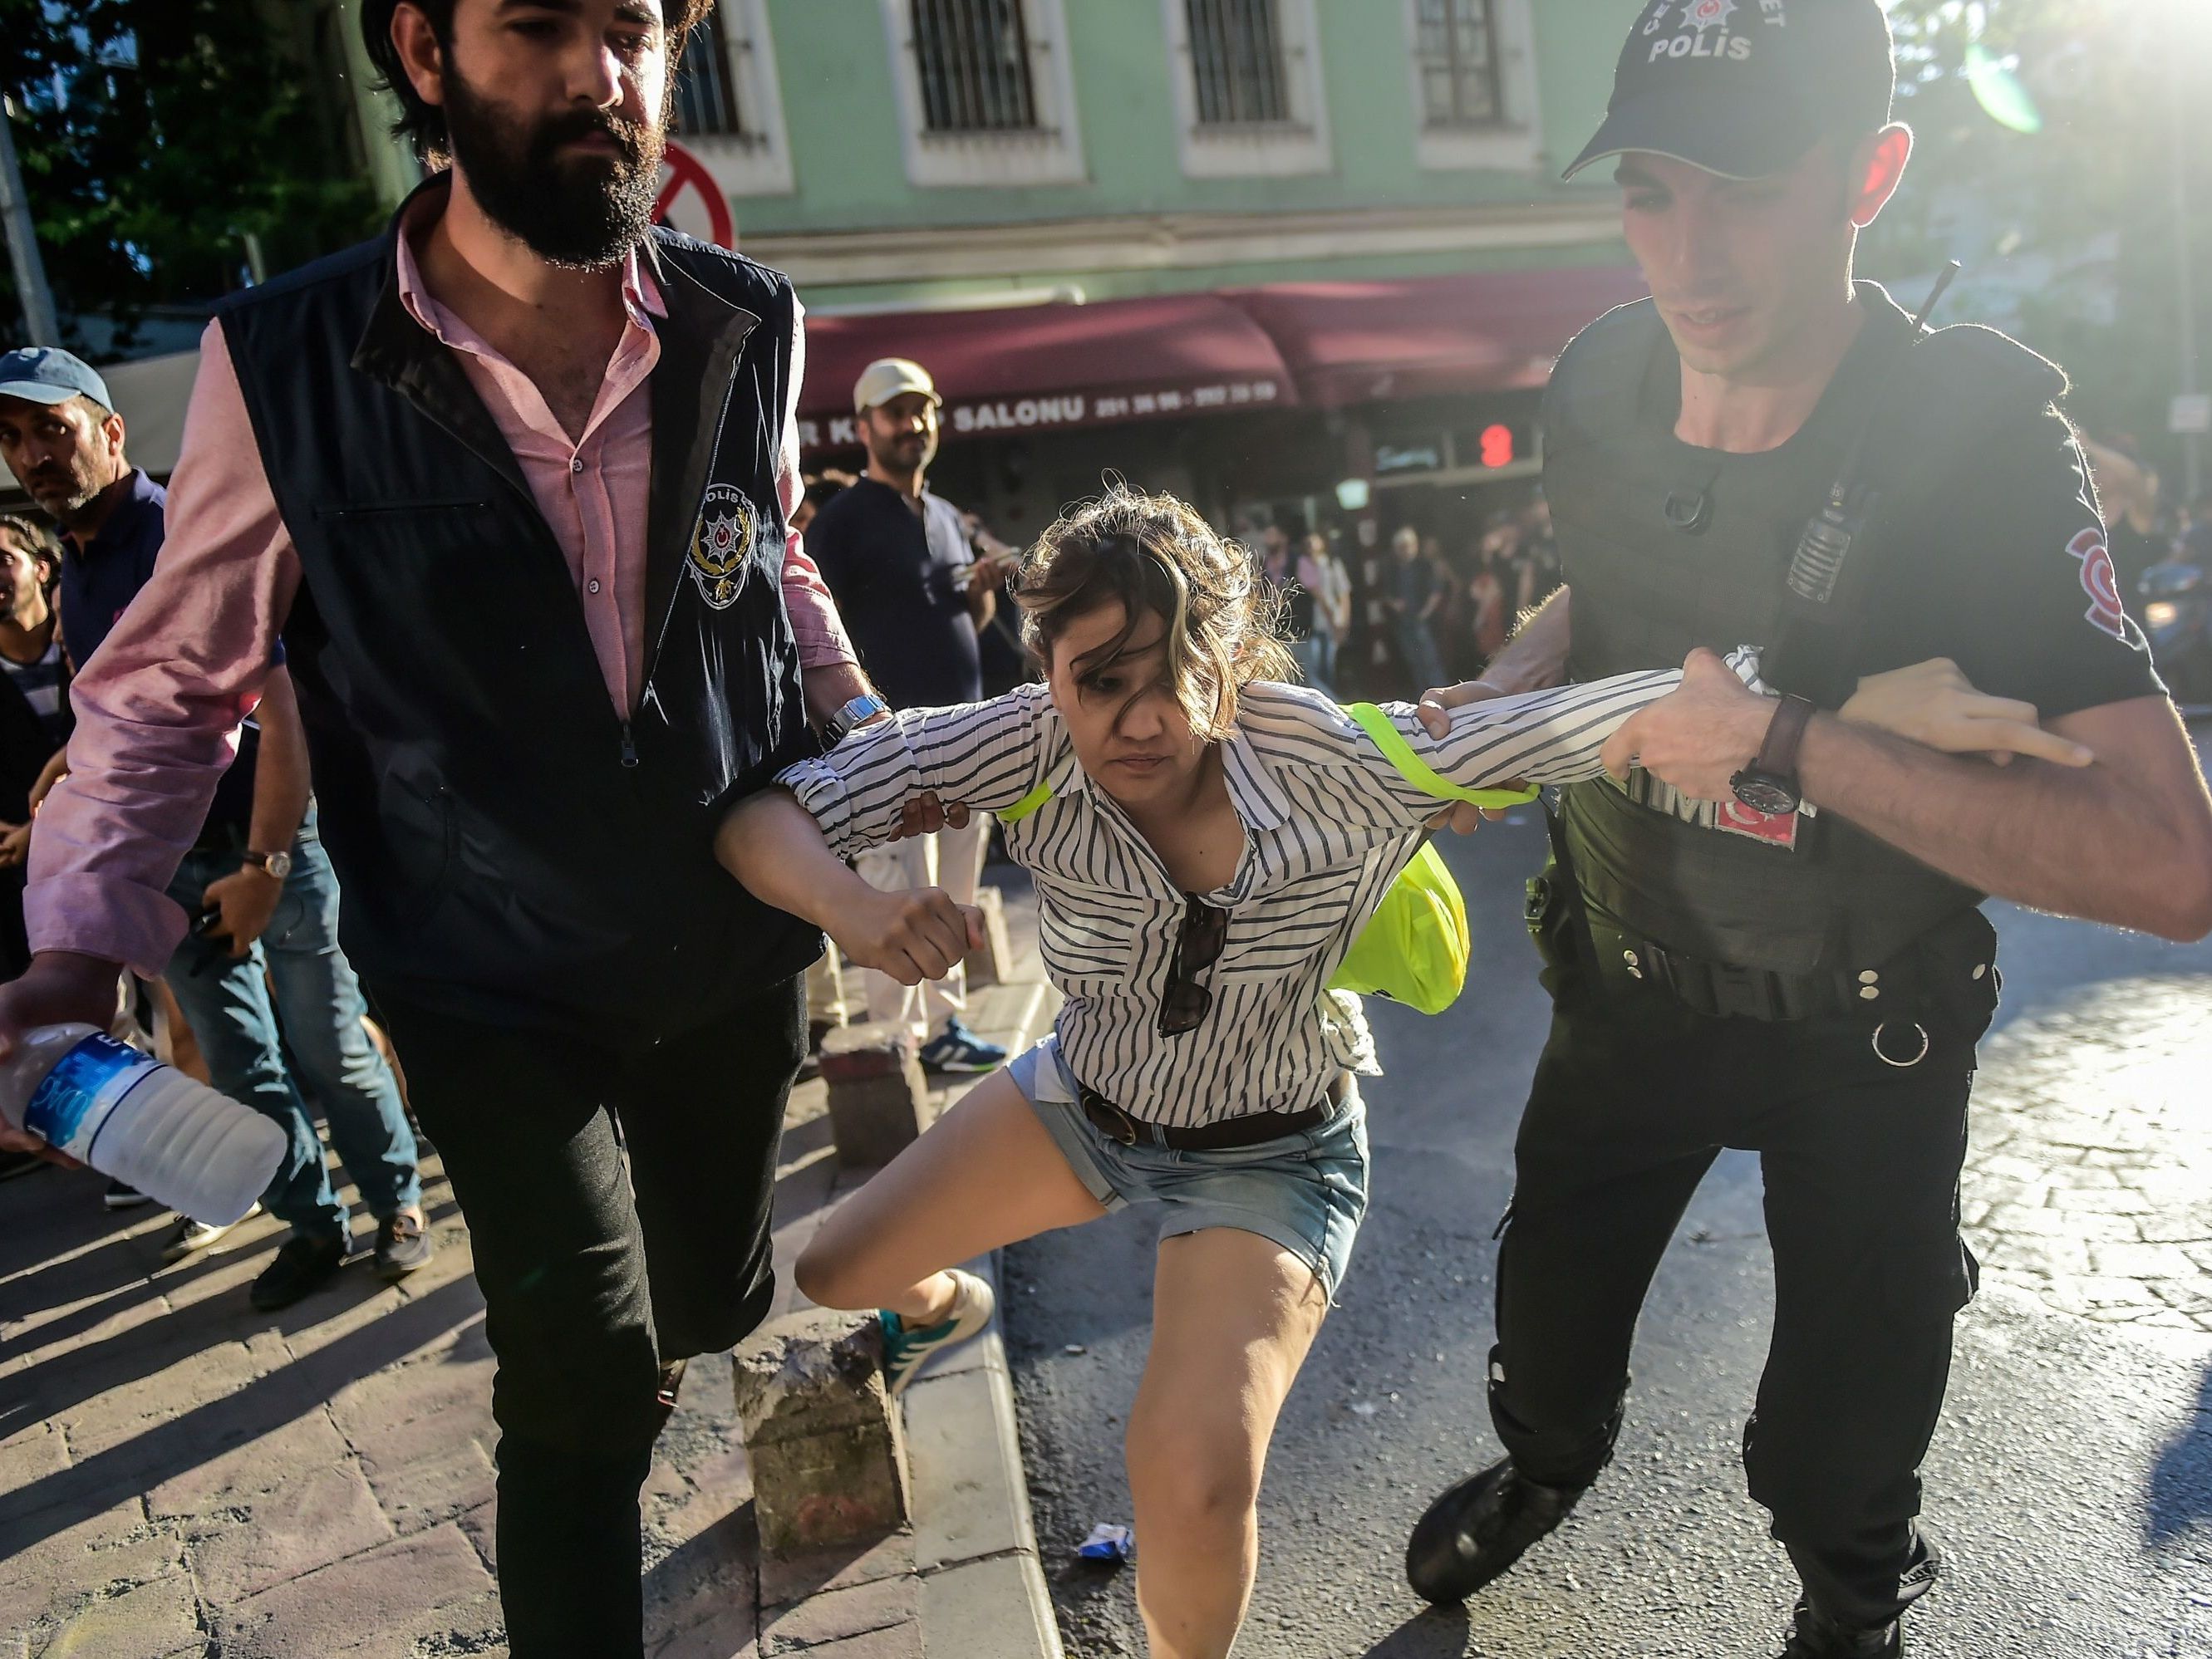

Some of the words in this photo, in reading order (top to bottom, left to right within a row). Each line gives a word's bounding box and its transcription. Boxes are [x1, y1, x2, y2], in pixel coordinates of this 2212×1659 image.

[1758, 0, 1786, 27] ET
[1647, 27, 1752, 63] POLİS
[953, 395, 1085, 433] SALONU
[705, 488, 739, 503] OLİS
